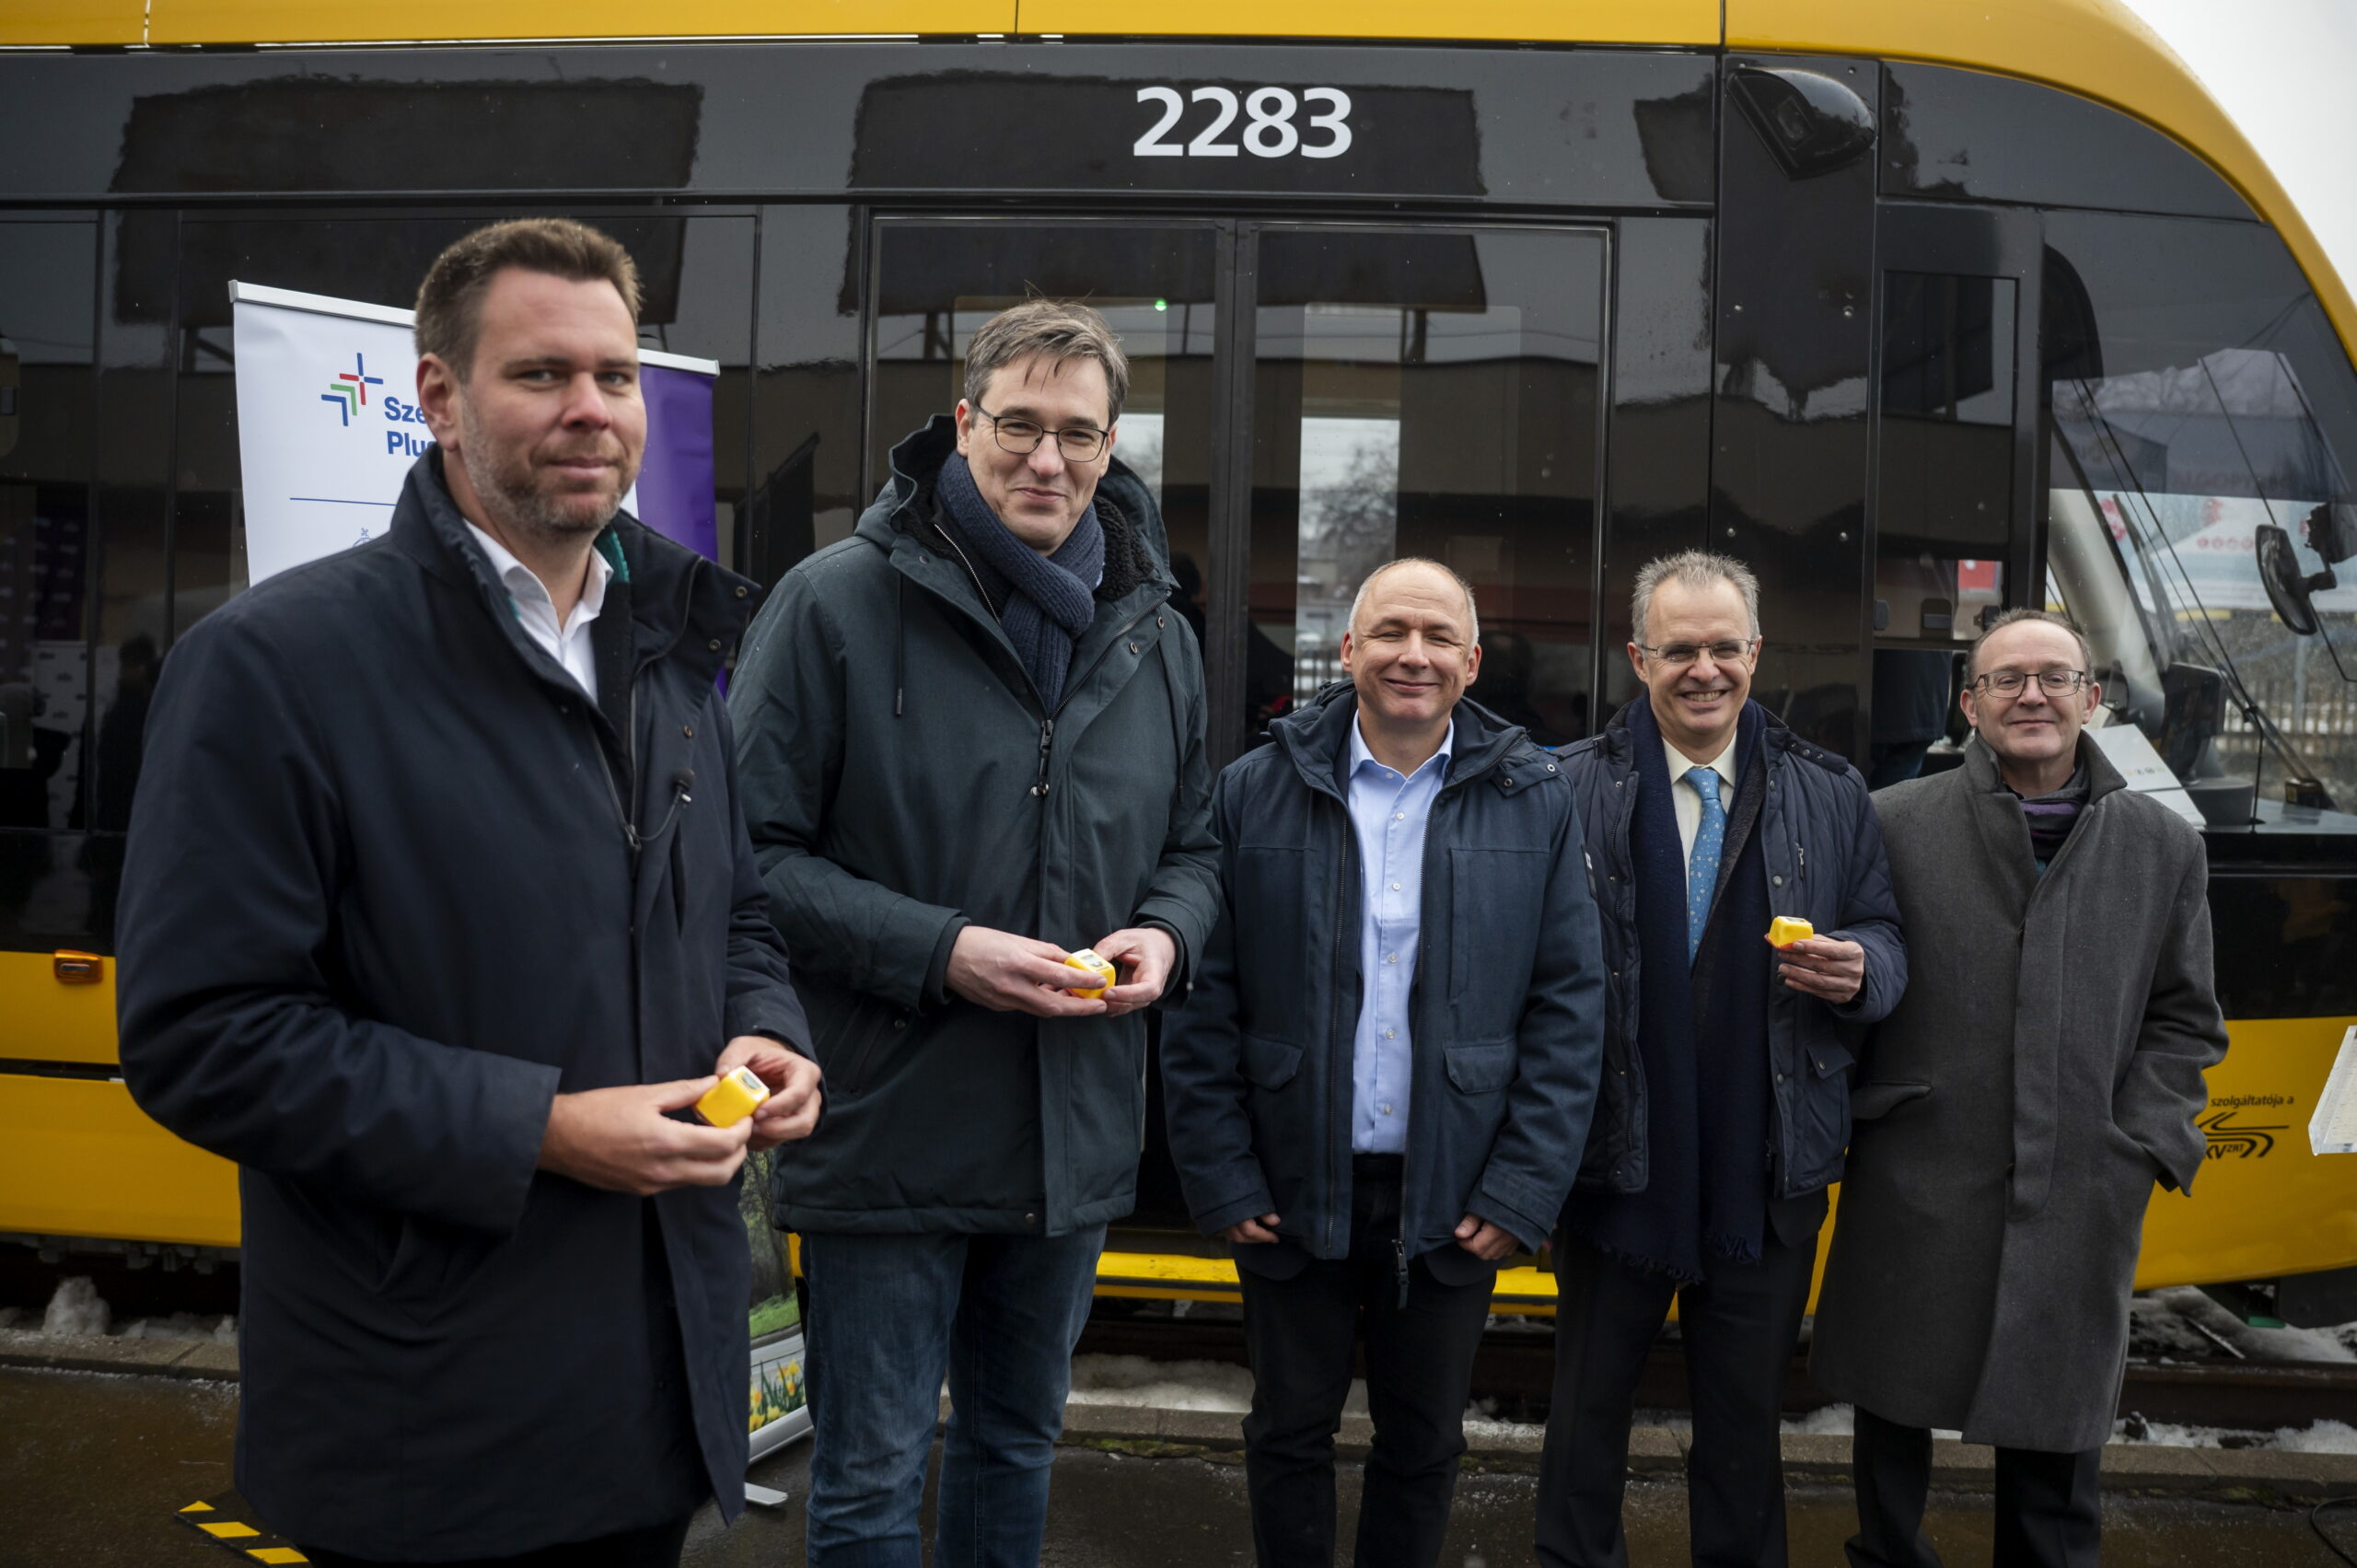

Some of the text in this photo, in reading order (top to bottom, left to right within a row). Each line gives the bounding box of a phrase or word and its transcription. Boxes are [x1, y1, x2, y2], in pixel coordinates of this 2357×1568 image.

[1133, 86, 1353, 158] 2283
[387, 430, 436, 458] Plu
[2211, 1094, 2294, 1109] szolgáltatója a
